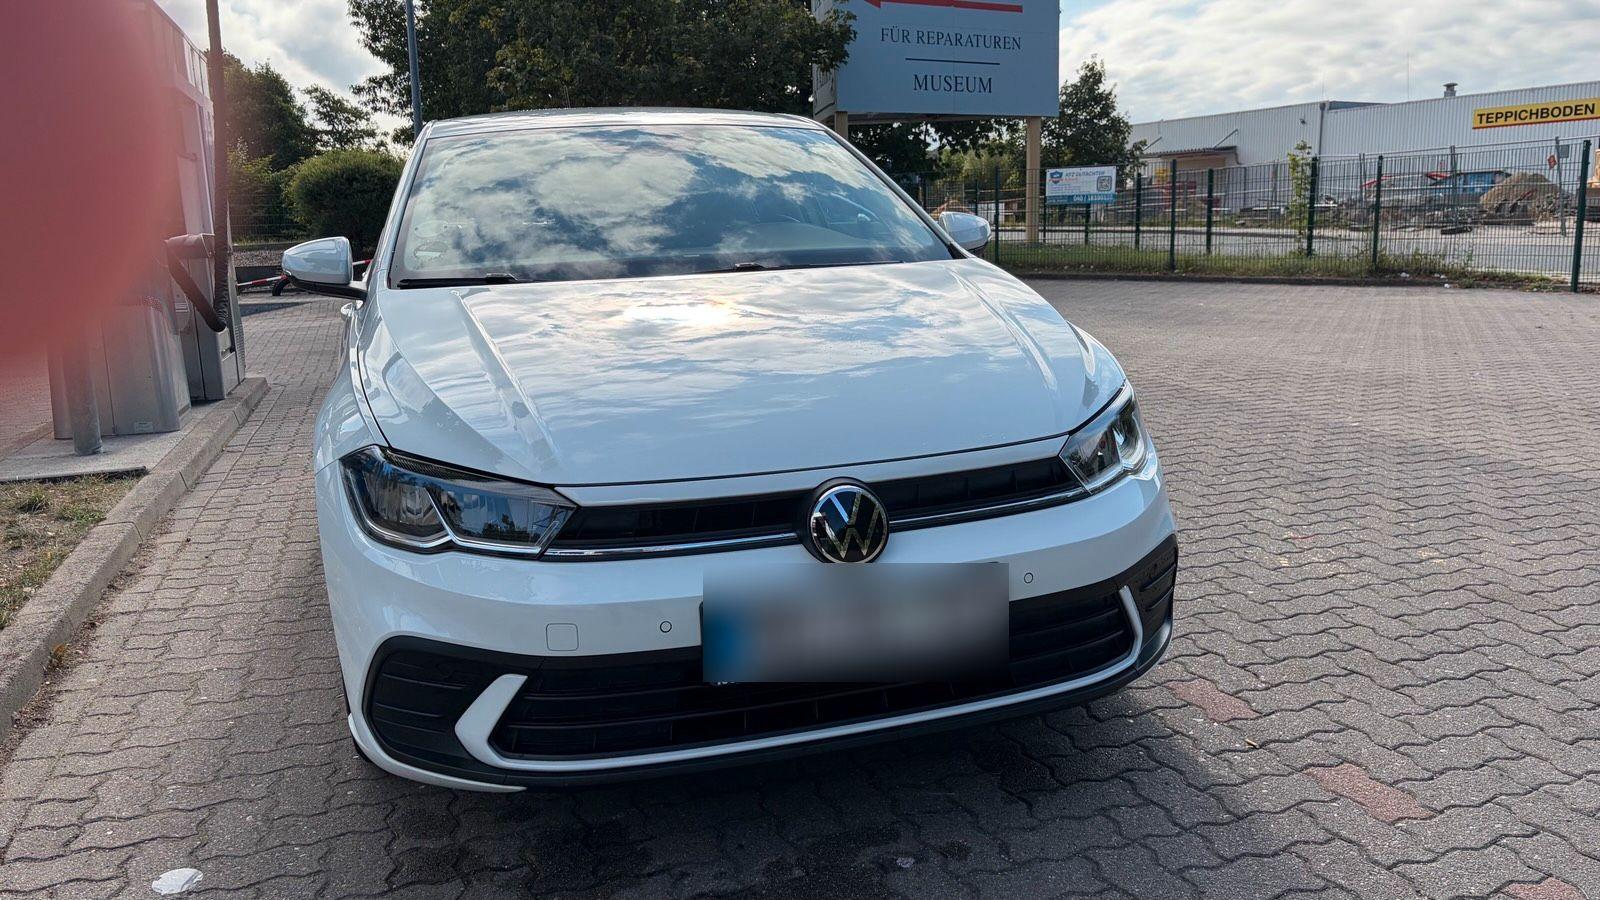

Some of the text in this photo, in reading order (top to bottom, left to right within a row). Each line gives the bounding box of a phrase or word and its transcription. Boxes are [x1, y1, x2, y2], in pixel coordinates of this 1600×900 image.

[881, 25, 1021, 50] FÜR REPARATUREN
[913, 74, 992, 93] MUSEUM
[1477, 103, 1596, 124] TEPPICHBODEN
